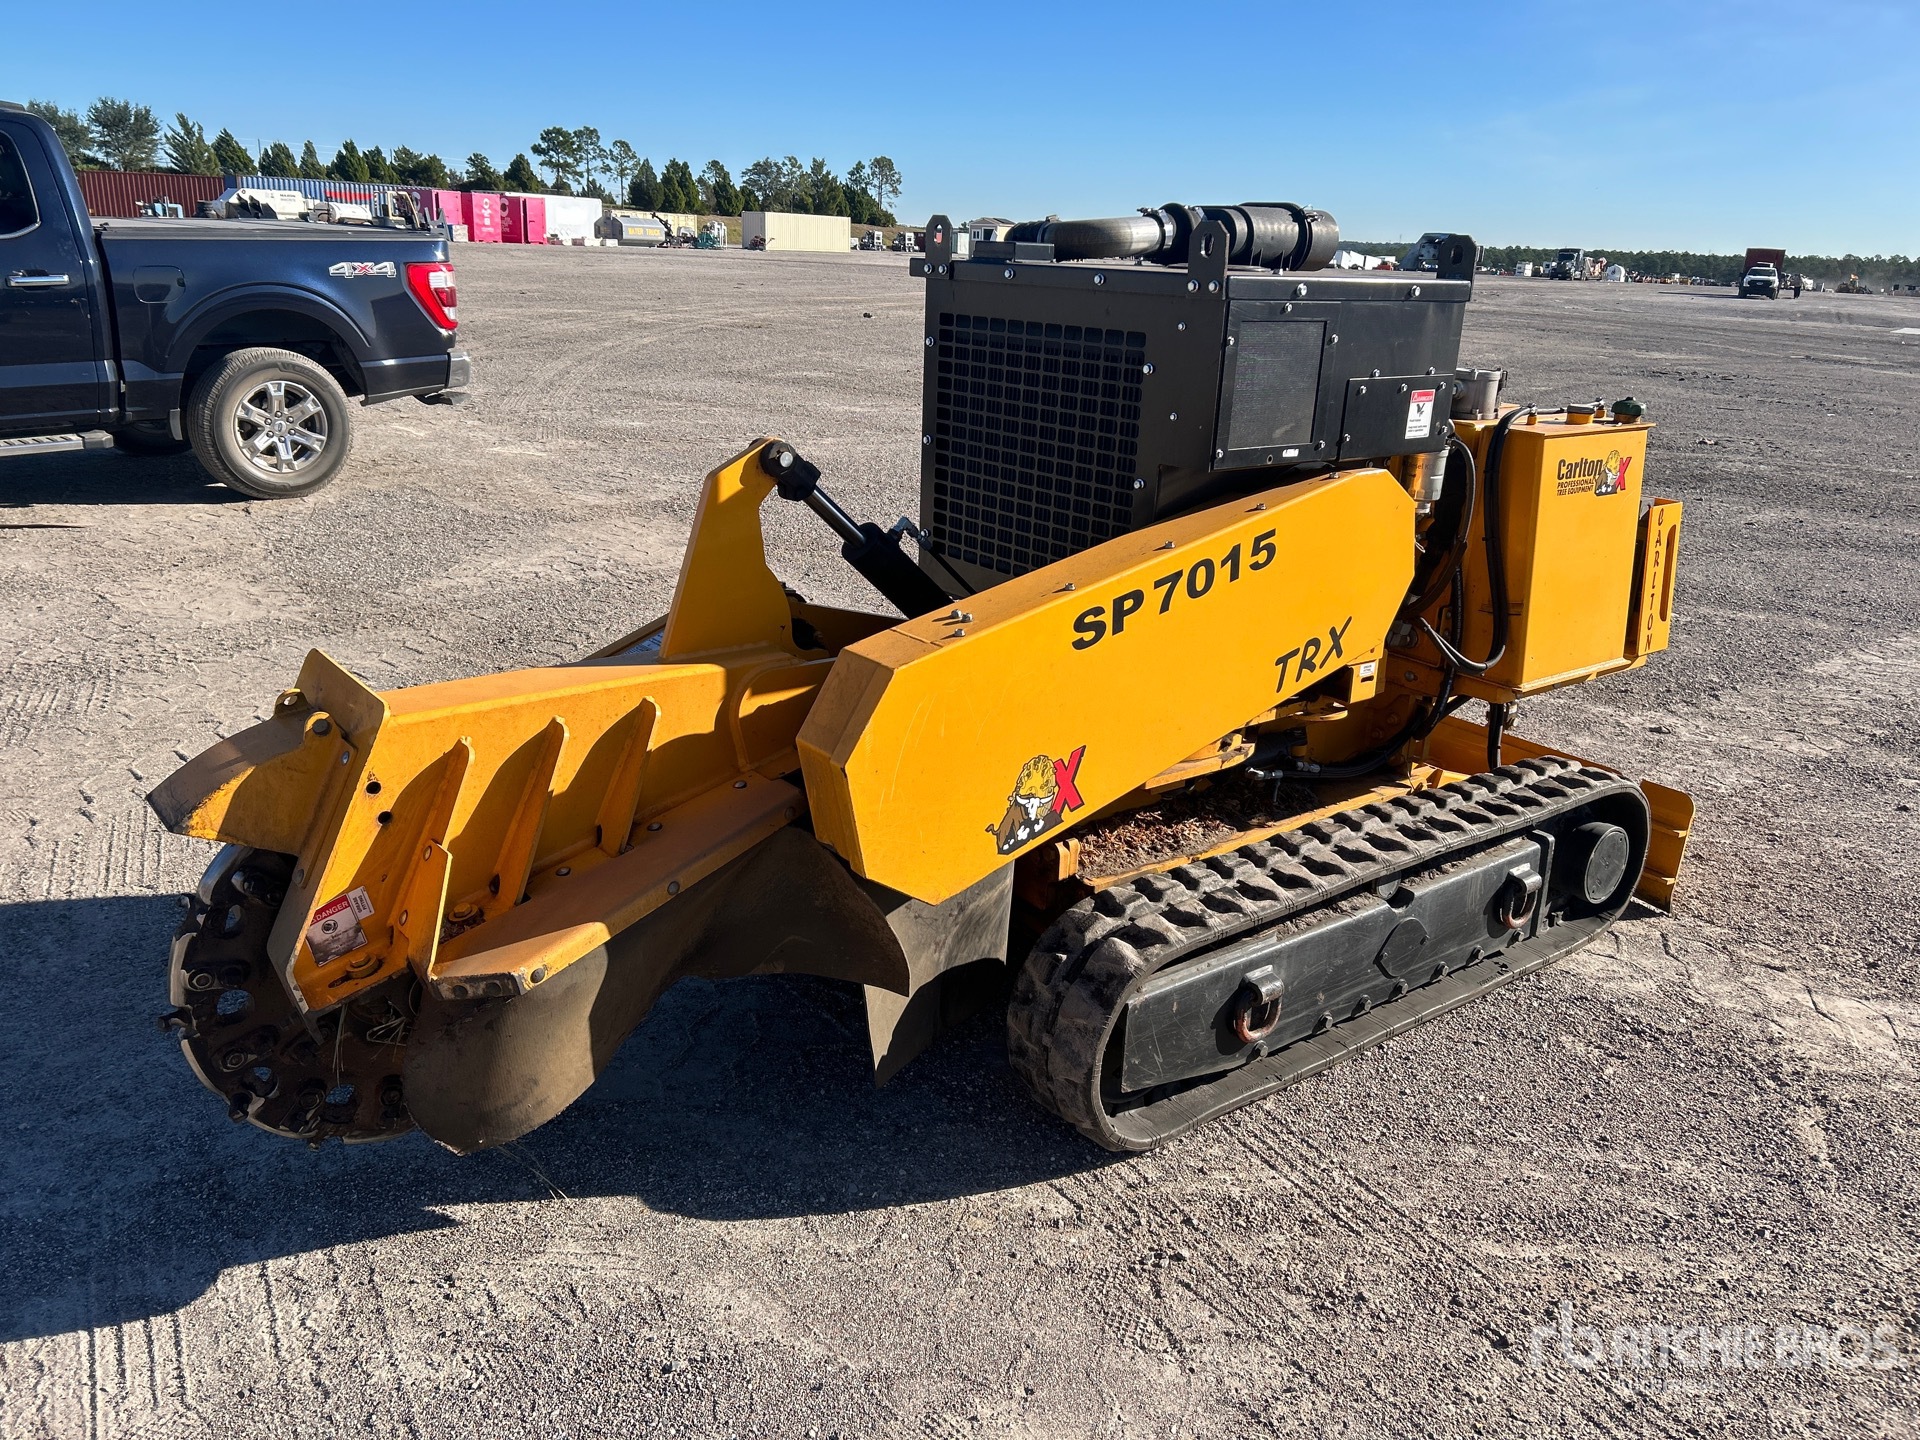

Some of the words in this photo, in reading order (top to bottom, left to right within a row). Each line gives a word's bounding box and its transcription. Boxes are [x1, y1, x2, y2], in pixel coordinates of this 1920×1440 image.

[1557, 457, 1604, 481] Carlton
[1557, 478, 1595, 489] PROFESSIONAL
[1567, 485, 1594, 495] EQUIPMENT
[1645, 508, 1664, 652] CARLTON
[1274, 615, 1353, 694] TRX
[315, 901, 349, 921] DANGER
